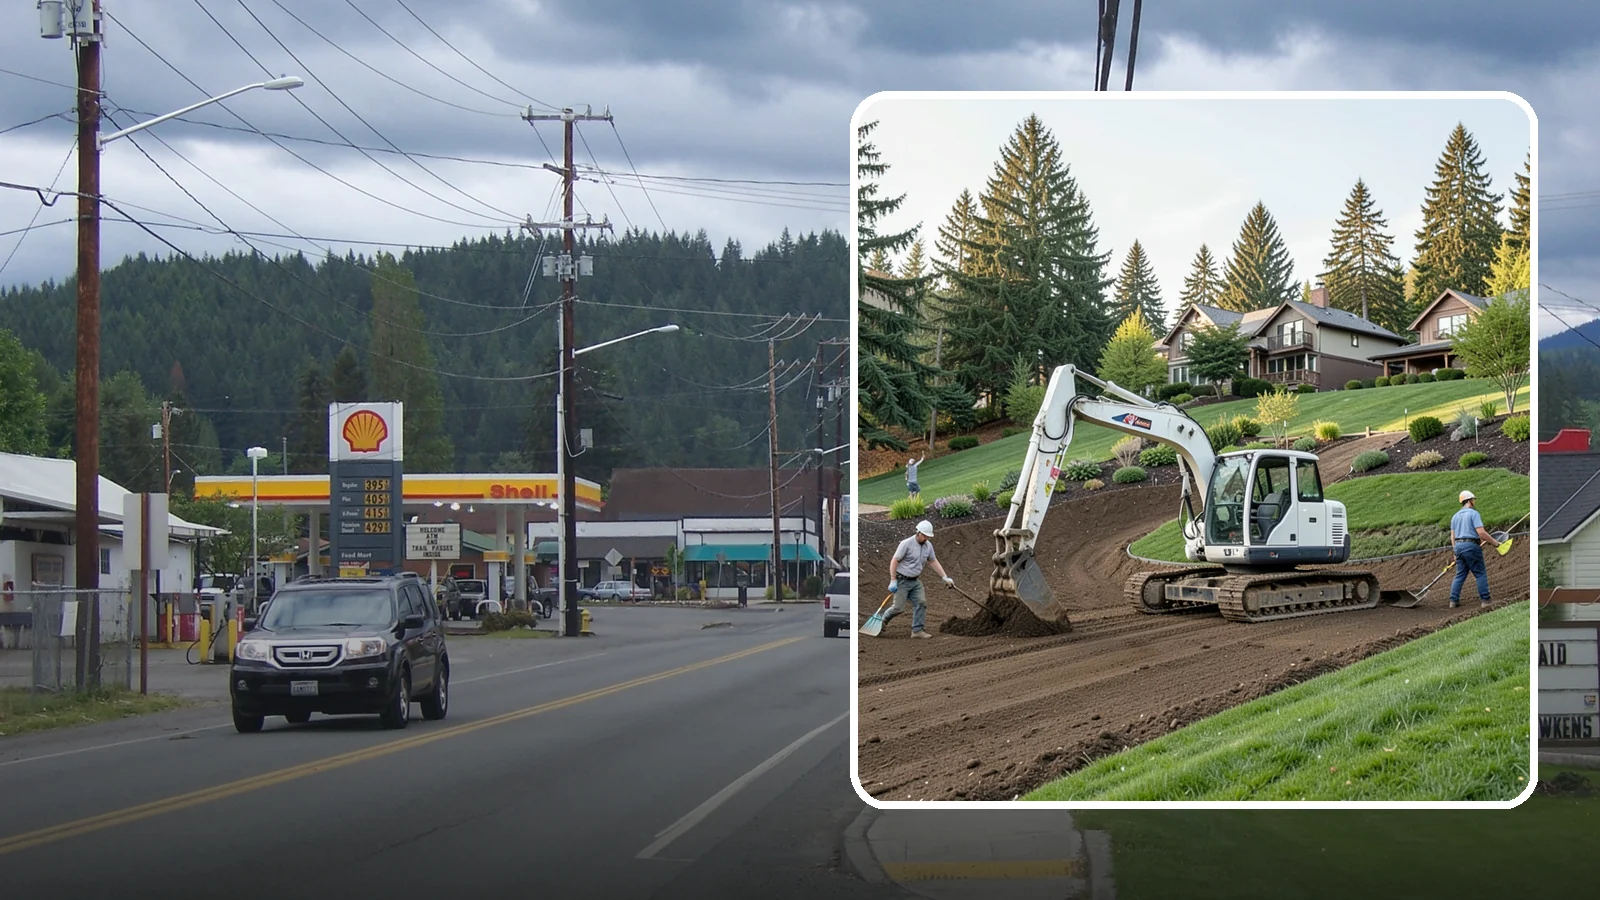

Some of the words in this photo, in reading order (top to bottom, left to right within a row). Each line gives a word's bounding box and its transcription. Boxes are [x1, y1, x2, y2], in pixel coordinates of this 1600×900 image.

[366, 480, 383, 490] 395
[490, 484, 547, 499] Shell
[366, 494, 383, 504] 405
[366, 508, 383, 518] 415
[366, 522, 383, 532] 429
